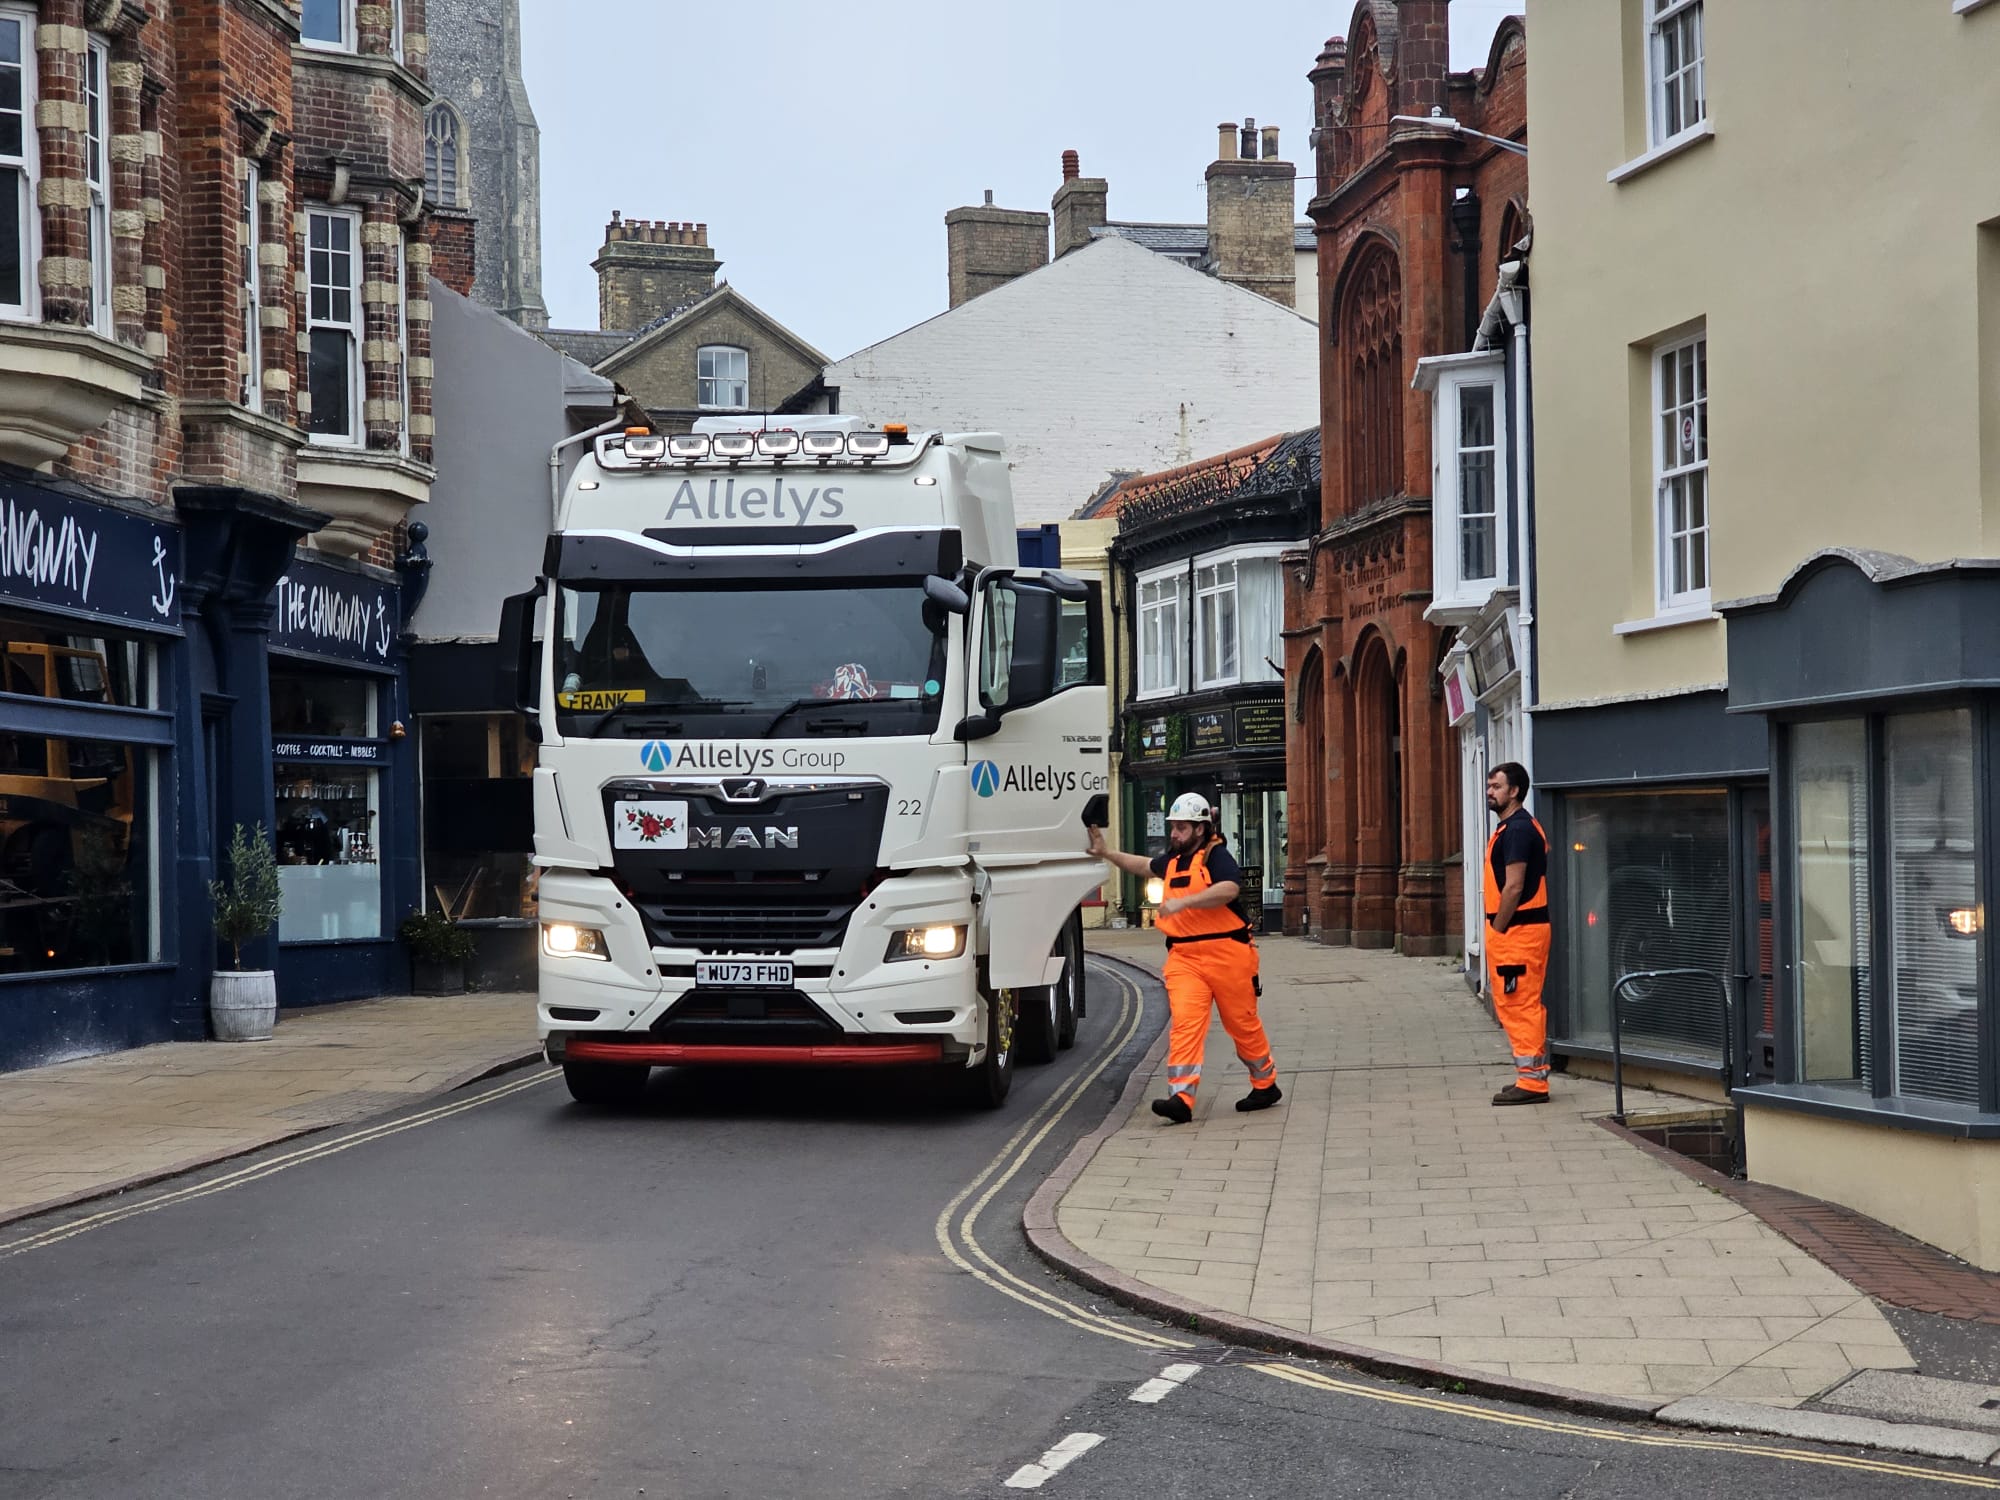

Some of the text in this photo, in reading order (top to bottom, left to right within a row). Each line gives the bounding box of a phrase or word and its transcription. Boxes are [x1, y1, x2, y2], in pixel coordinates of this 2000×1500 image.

[664, 478, 844, 526] Allelys
[276, 576, 371, 653] THE GANGWAY
[569, 692, 628, 709] FRANK
[276, 744, 377, 758] COFFEE COCKTAILS NIBBLES
[676, 743, 845, 775] Allelys Group
[1003, 764, 1076, 800] Allelys
[898, 799, 922, 816] 22
[688, 826, 798, 849] MAN
[1245, 878, 1261, 887] OLD
[708, 965, 789, 982] WU73 FHD
